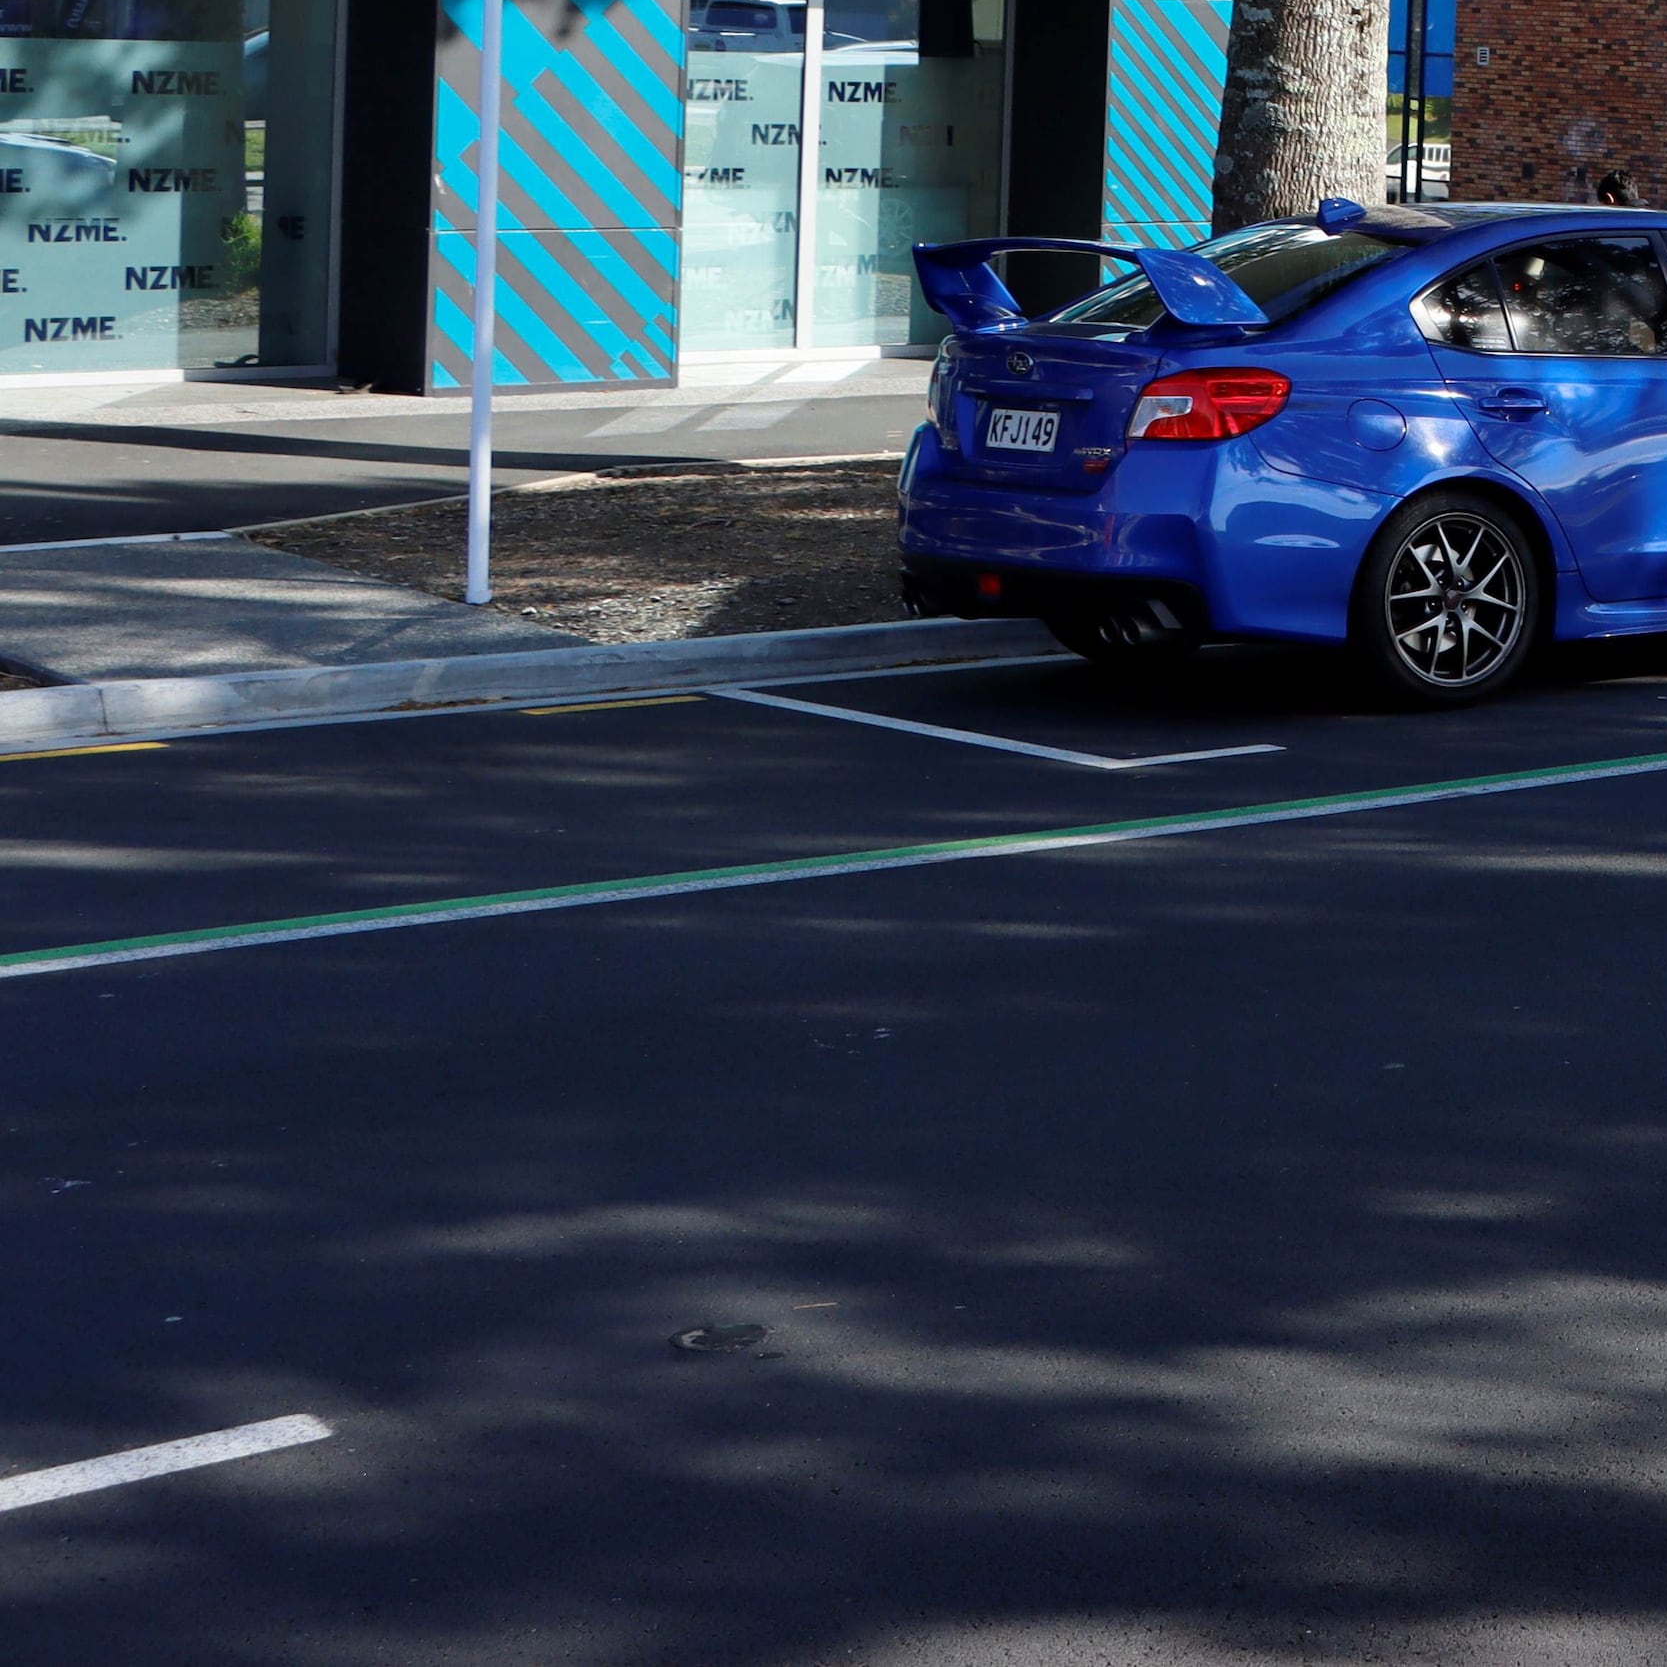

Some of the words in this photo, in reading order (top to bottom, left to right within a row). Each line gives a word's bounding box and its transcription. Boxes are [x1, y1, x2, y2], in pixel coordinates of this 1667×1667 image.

[27, 217, 128, 243] NZME.
[24, 316, 124, 343] NZME.
[989, 414, 1055, 447] KFJ149
